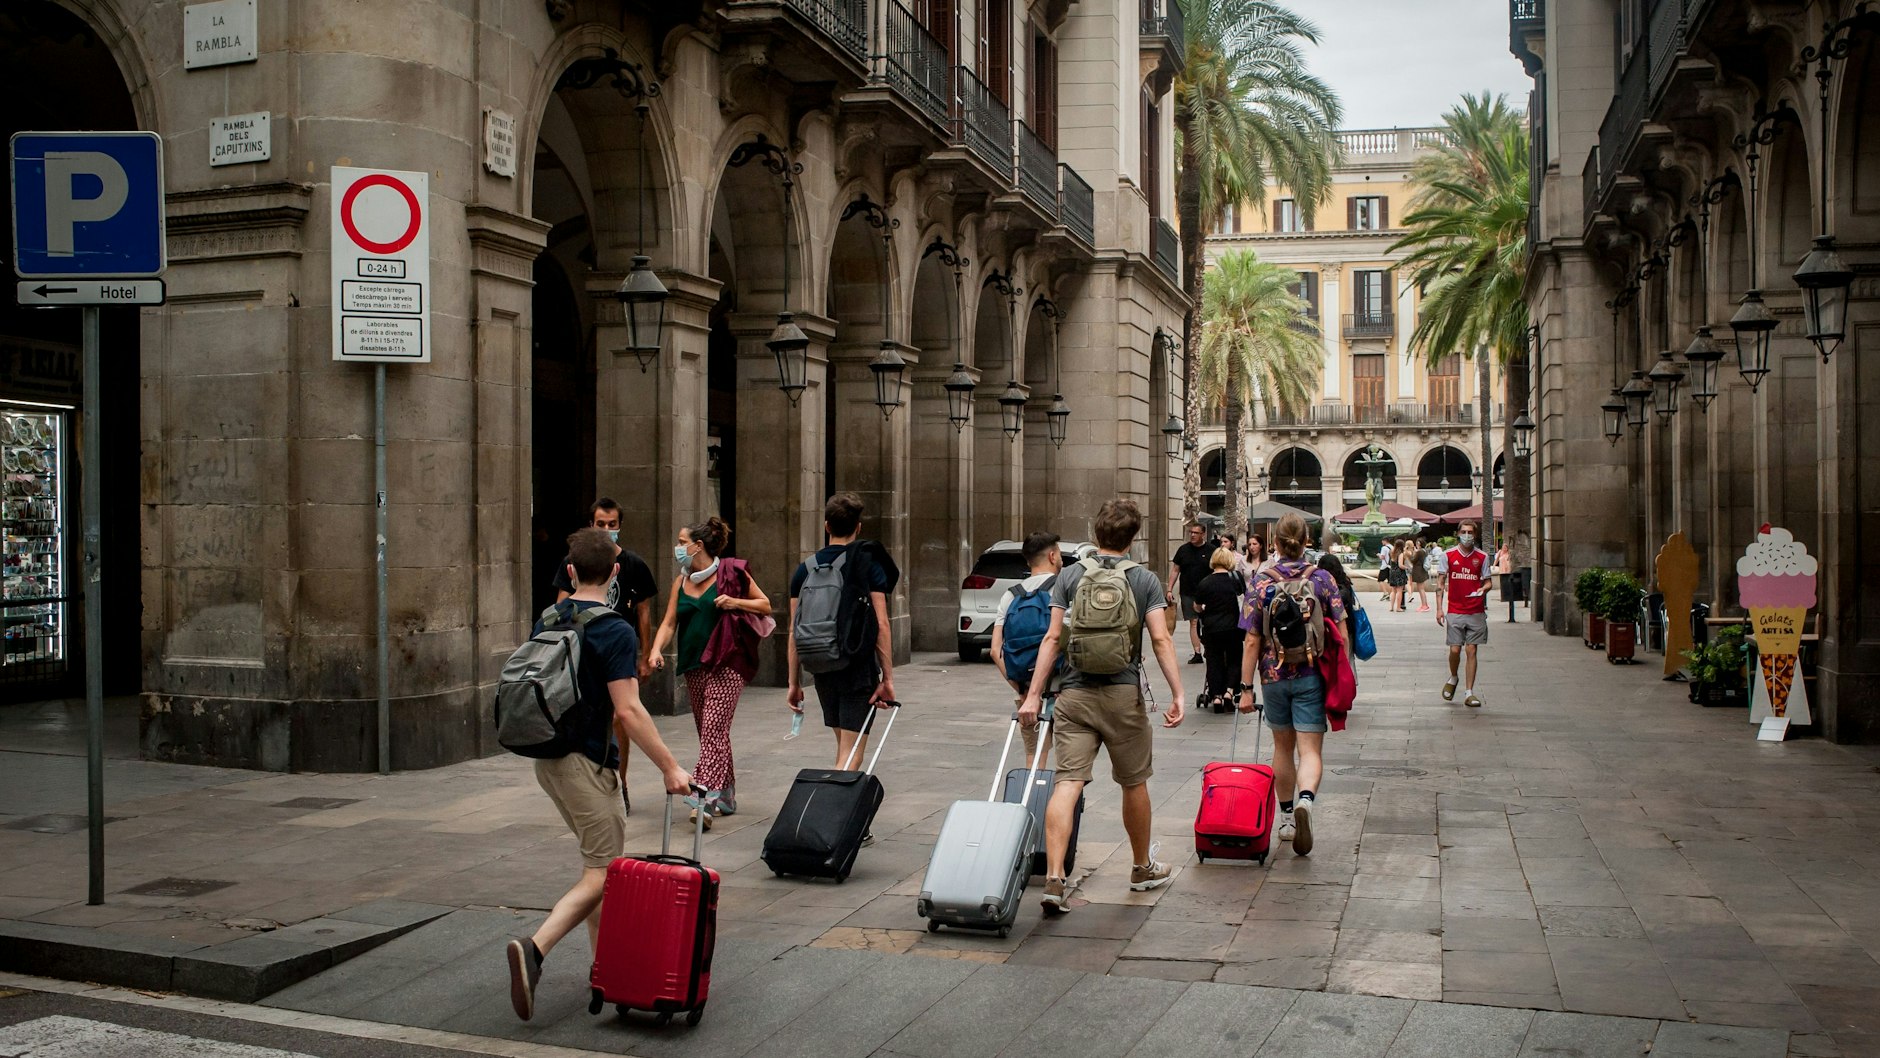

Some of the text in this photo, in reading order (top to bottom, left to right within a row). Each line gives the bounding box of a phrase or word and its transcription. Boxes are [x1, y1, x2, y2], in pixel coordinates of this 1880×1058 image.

[212, 15, 225, 27] LA
[196, 35, 242, 52] RAMBLA
[223, 119, 255, 131] RAMBLA
[229, 131, 249, 141] DELS
[215, 140, 263, 156] CAPUTXINS
[44, 151, 129, 257] P
[367, 263, 397, 273] 0-24 h
[100, 285, 137, 299] Hotel
[359, 285, 382, 293] Excepte
[1451, 572, 1478, 580] Emirates
[1760, 612, 1794, 626] Gelats
